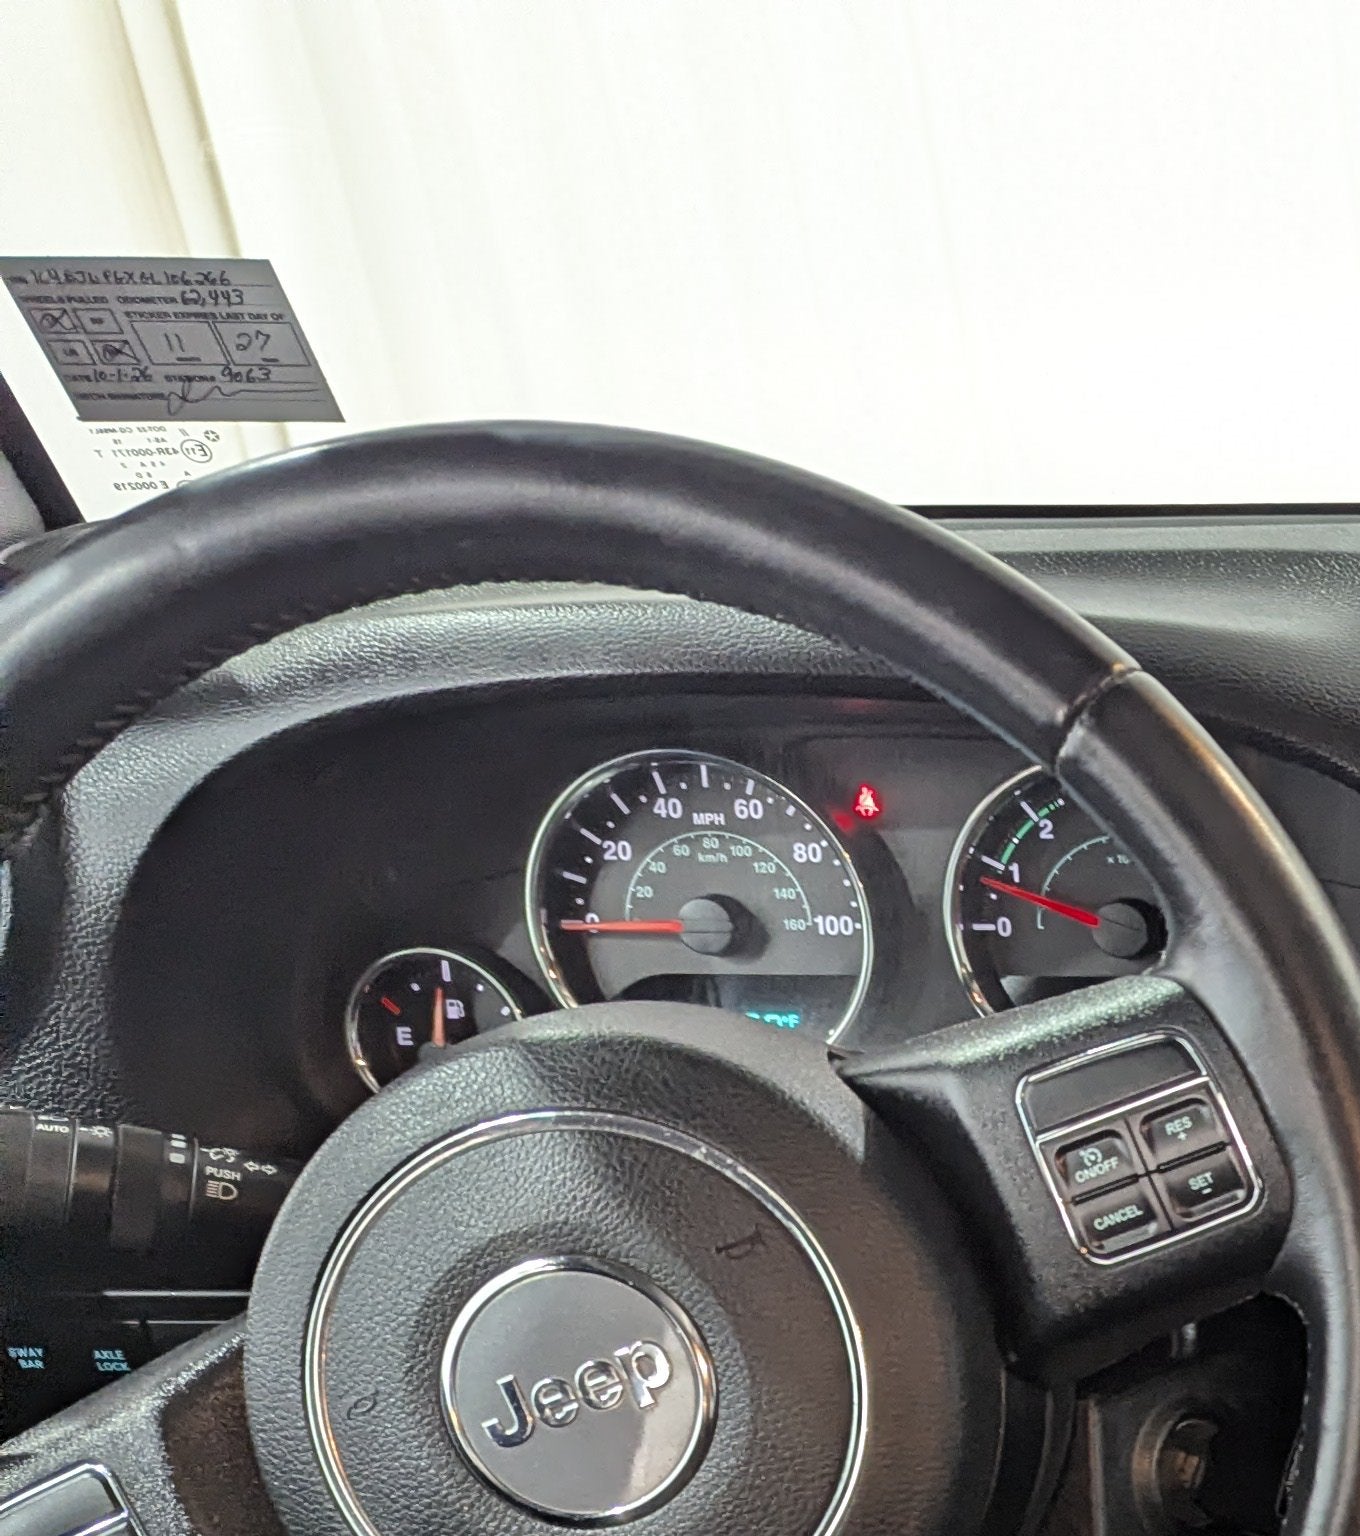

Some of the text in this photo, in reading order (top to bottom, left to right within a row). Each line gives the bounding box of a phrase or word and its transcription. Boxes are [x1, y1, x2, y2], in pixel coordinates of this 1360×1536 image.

[654, 798, 682, 818] 40
[735, 799, 763, 819] 60
[693, 813, 725, 825] MPH
[1038, 818, 1054, 839] 2
[603, 841, 631, 861] 20
[673, 844, 690, 857] 60
[703, 838, 719, 848] 80
[729, 844, 752, 857] 100
[698, 853, 727, 862] km/h
[792, 842, 822, 864] 80
[649, 860, 665, 873] 40
[753, 860, 777, 873] 120
[1009, 863, 1019, 882] 1
[636, 886, 653, 899] 20
[813, 914, 854, 937] 100
[998, 917, 1011, 936] 0
[397, 1027, 413, 1045] E
[35, 1121, 70, 1134] AUTO
[1164, 1116, 1193, 1135] RES
[206, 1166, 240, 1182] PUSH
[1074, 1156, 1119, 1183] ON/OFF
[1188, 1172, 1214, 1190] SET
[1093, 1204, 1144, 1230] CANCEL
[482, 1340, 673, 1448] Jeep
